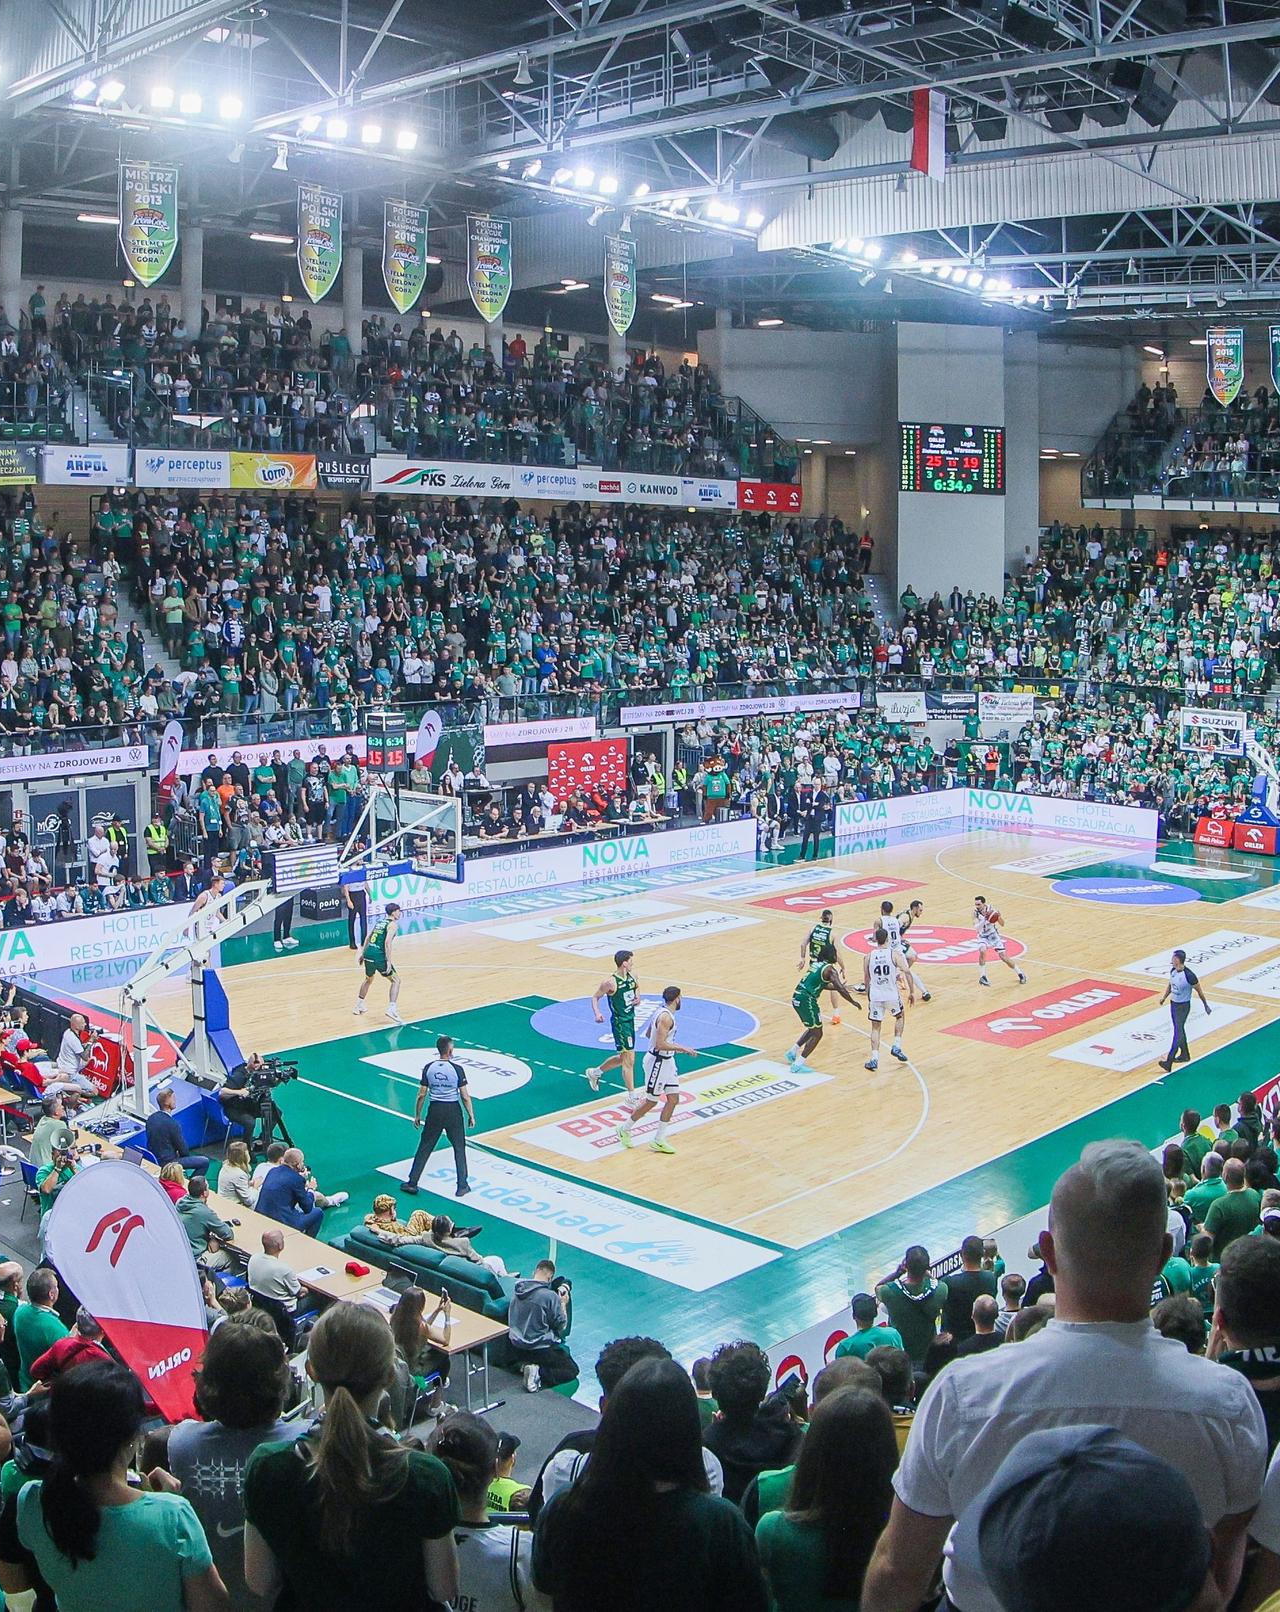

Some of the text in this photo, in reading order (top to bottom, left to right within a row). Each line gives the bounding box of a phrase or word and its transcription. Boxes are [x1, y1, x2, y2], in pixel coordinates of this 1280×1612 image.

[125, 168, 173, 184] MISTRZ
[125, 180, 172, 195] POLSKI
[134, 194, 162, 206] 2013
[301, 192, 338, 207] MISTRZ
[302, 203, 337, 219] POLSKI
[393, 206, 419, 219] POLISH
[308, 215, 330, 228] 2015
[475, 220, 503, 231] POLISH
[387, 222, 424, 235] CHAMPIONS
[394, 230, 416, 243] 2016
[470, 235, 508, 246] CHAMPIONS
[131, 239, 165, 248] STELMET
[478, 243, 500, 254] 2017
[131, 247, 164, 256] ZIELONA
[136, 254, 159, 264] GÓRA
[611, 261, 629, 272] 2020
[1209, 338, 1240, 346] POLSKI
[1215, 348, 1234, 356] 2015
[66, 460, 108, 472] ARPOL
[168, 459, 222, 472] perceptus
[926, 455, 942, 467] 25
[963, 457, 979, 468] 19
[420, 473, 511, 490] PKS Zielona Góra
[536, 475, 577, 487] perceptus
[926, 471, 933, 479] 3
[949, 472, 956, 480] 2
[582, 482, 597, 490] radio
[639, 484, 678, 496] KANWOD
[698, 488, 722, 498] ARPOL
[739, 703, 768, 712] ZDROJOWEJ
[1201, 717, 1237, 727] SUZUKI
[368, 736, 382, 747] 6:34
[386, 736, 404, 747] 6:34
[38, 762, 51, 770] NA
[53, 757, 108, 770] ZDROJOWEJ
[110, 755, 122, 764] 2B
[369, 751, 382, 765] 15
[387, 751, 403, 765] 15
[968, 790, 1034, 815] NOVA
[839, 801, 887, 826] NOVA
[1076, 804, 1114, 819] HOTEL
[1054, 815, 1136, 835] RESTAURACJA
[689, 828, 721, 842] HOTEL
[670, 840, 740, 862] RESTAURACJA
[1244, 841, 1264, 849] ORLEN
[582, 837, 649, 868] NOVA
[492, 855, 534, 873] HOTEL
[582, 860, 650, 878] RESTAURACJA
[468, 870, 557, 895] RESTAURACJA
[821, 880, 898, 899] ORLEN
[103, 913, 159, 935] HOTEL
[616, 926, 672, 943] Bank
[873, 965, 889, 976] 40
[1029, 988, 1121, 1021] ORLEN
[648, 1062, 662, 1089] LEGIA
[702, 1073, 769, 1100] MARCHE
[701, 1080, 798, 1115] POMORSKIE
[931, 1252, 963, 1279] OMORSK
